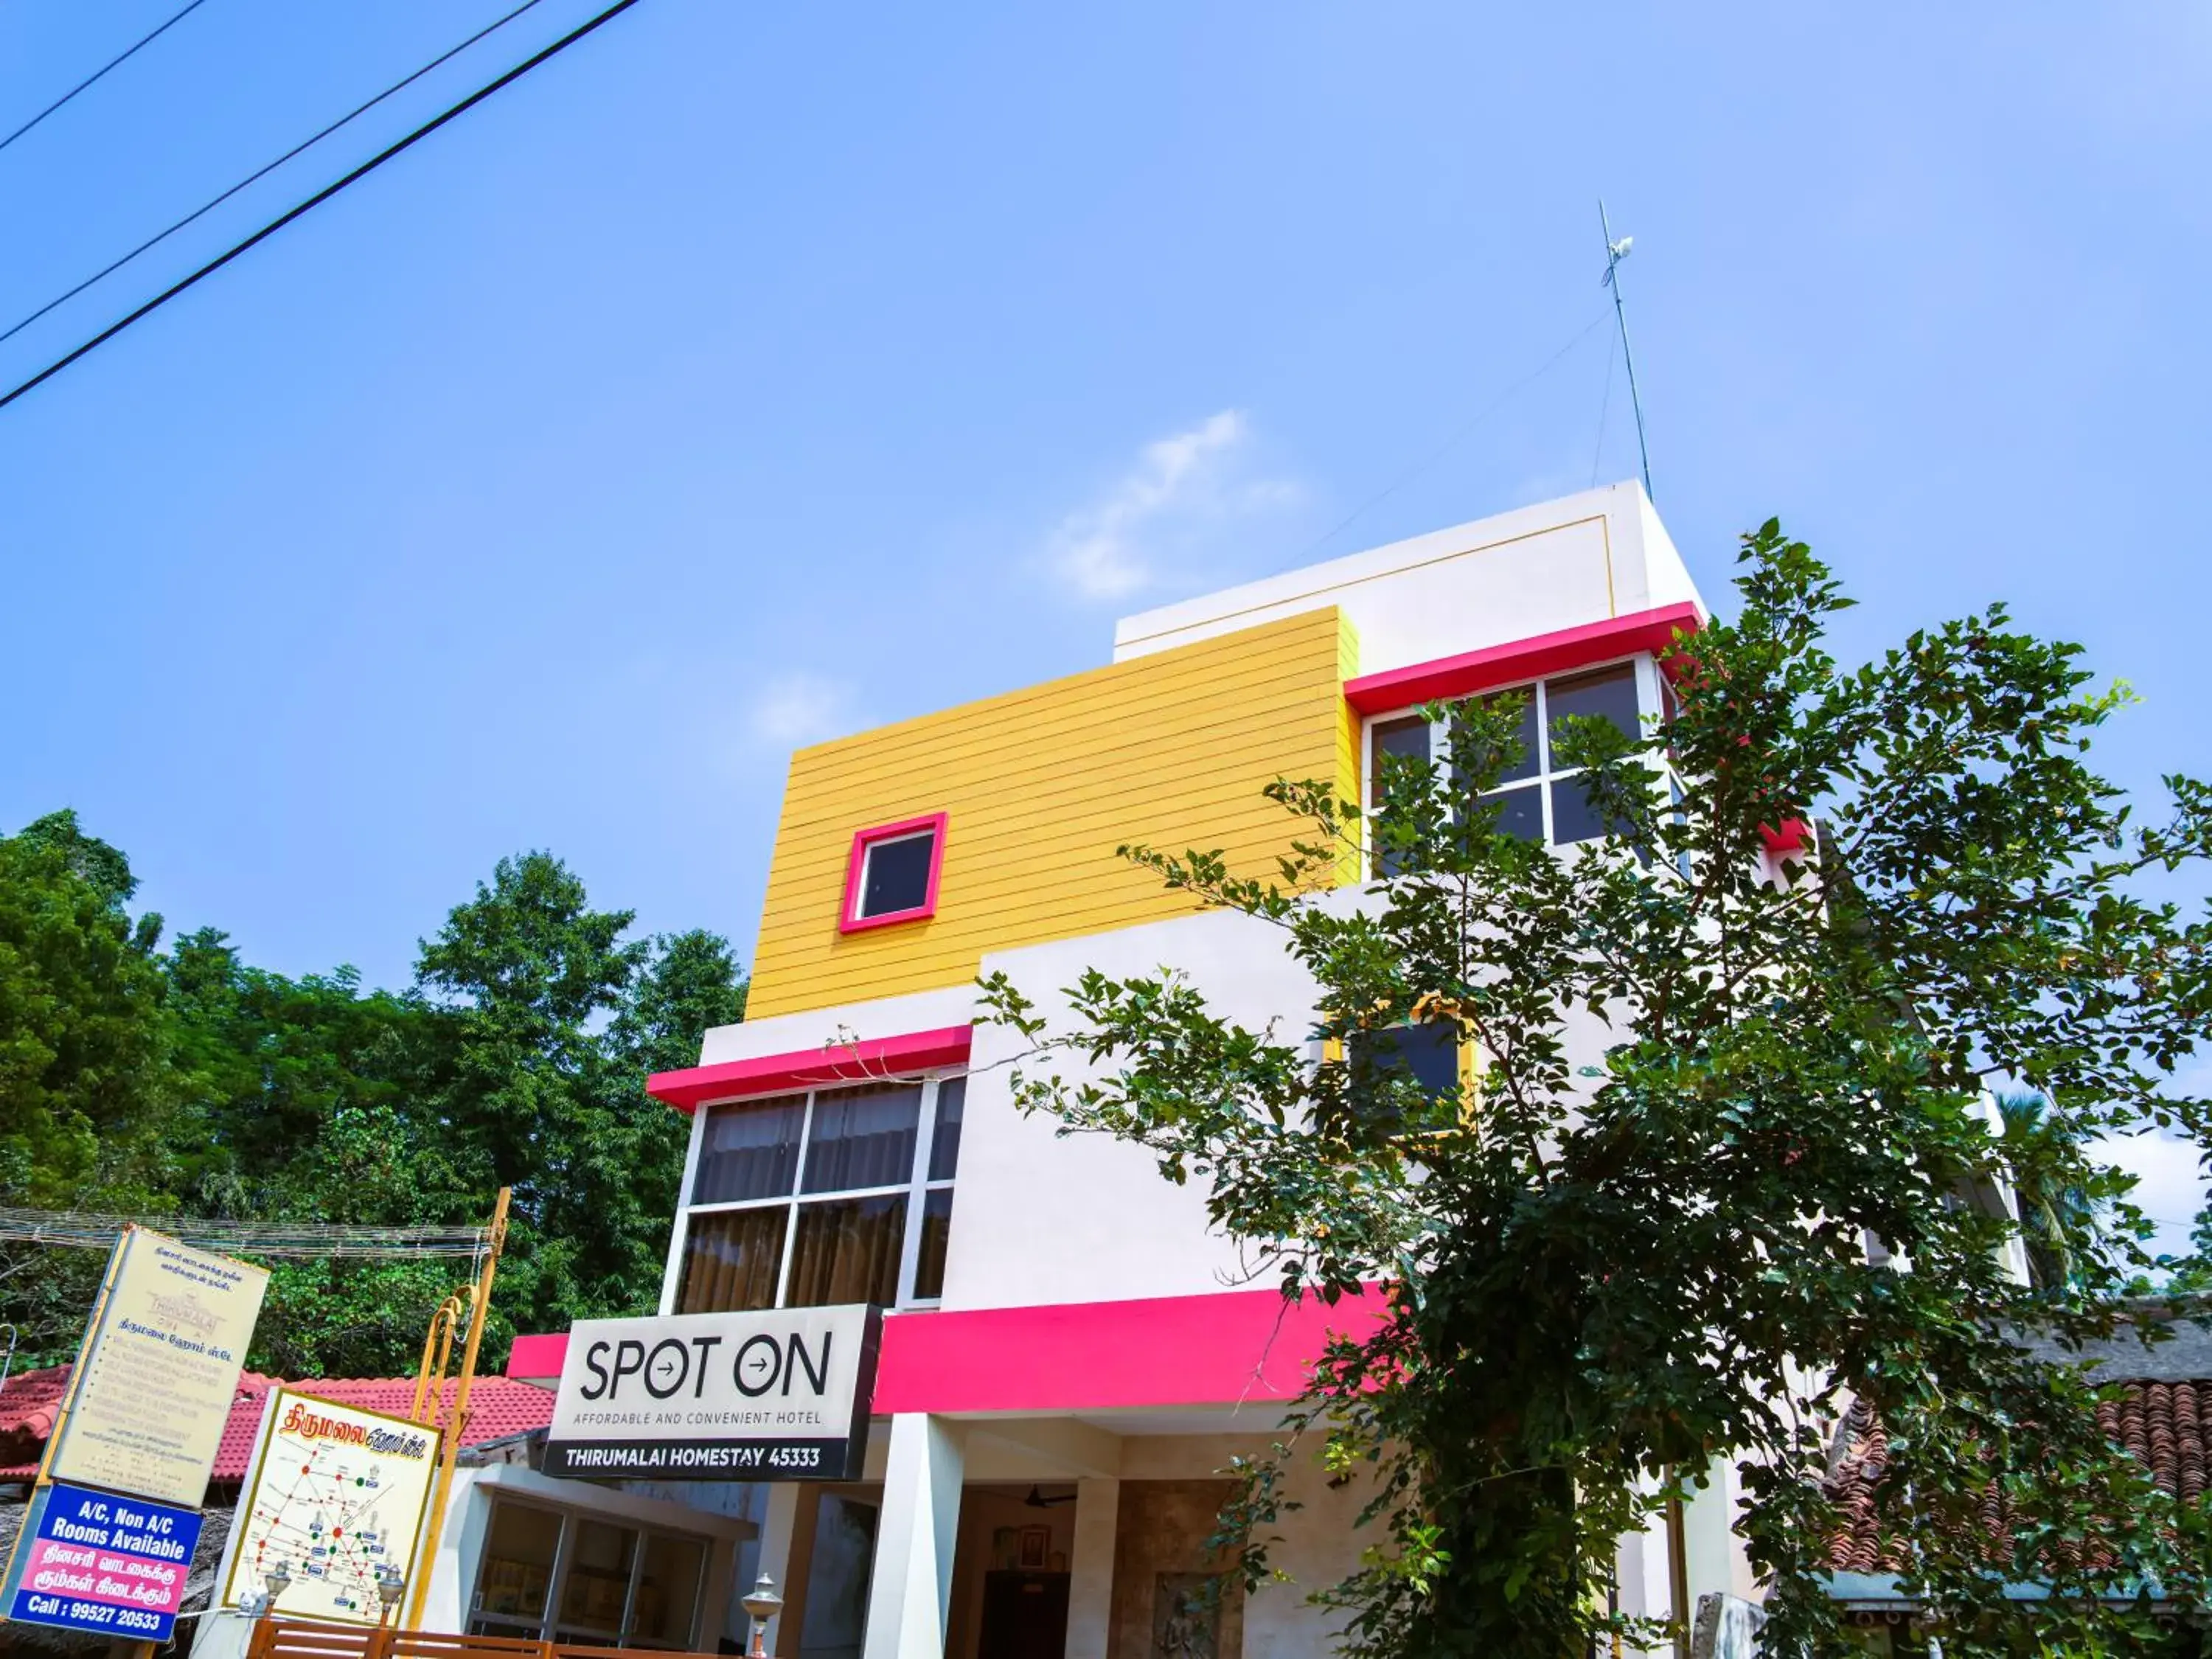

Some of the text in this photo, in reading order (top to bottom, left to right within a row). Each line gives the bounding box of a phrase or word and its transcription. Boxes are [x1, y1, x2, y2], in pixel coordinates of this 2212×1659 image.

[580, 1331, 832, 1400] SPOT ON
[279, 1402, 366, 1442] திருமலை
[573, 1411, 821, 1425] AFFORDABLE AND CONVENIENT HOTEL
[566, 1447, 821, 1467] THIRUMALAI HOMESTAY 45333
[78, 1500, 173, 1534] A/C, Non A/C
[52, 1517, 185, 1559] Rooms Available
[41, 1545, 176, 1585] தினசரி வாடகைக்கு
[34, 1568, 173, 1605] ரூம்கள் கிடைக்கும்
[28, 1595, 60, 1615] Call
[70, 1604, 116, 1623] 99527
[116, 1610, 161, 1630] 20533
